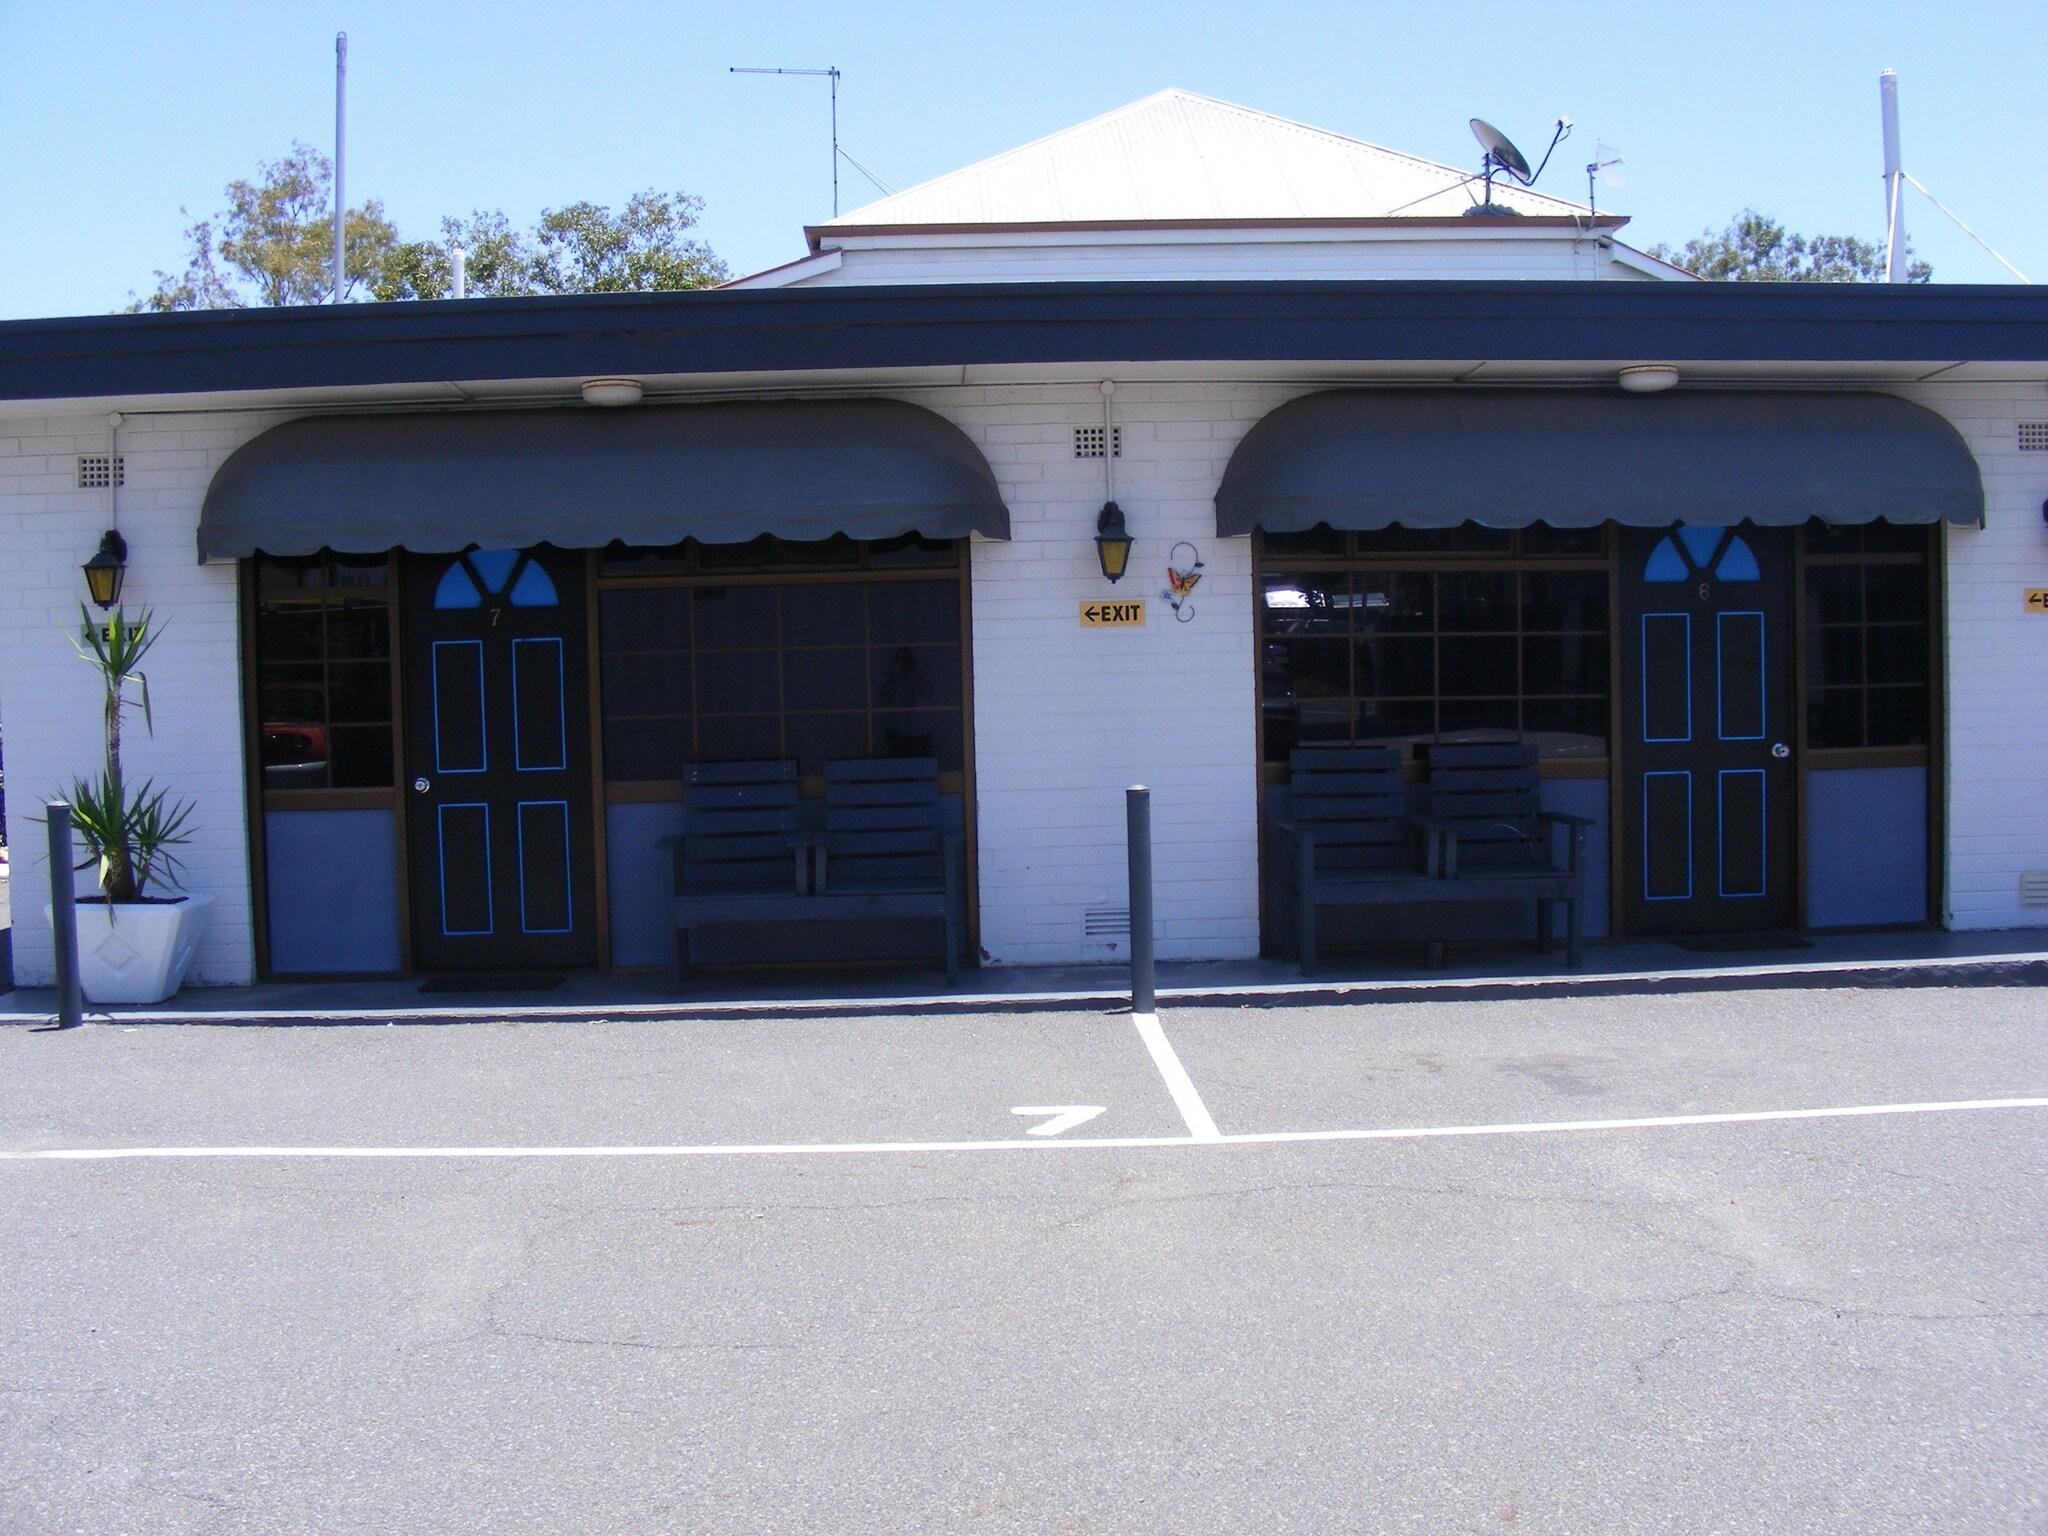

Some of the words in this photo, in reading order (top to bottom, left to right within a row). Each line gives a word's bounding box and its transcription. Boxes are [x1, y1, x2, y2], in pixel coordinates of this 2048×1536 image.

[1699, 583, 1710, 600] 6
[490, 608, 501, 627] 7
[1101, 605, 1140, 622] EXIT
[1010, 1105, 1107, 1136] 7
